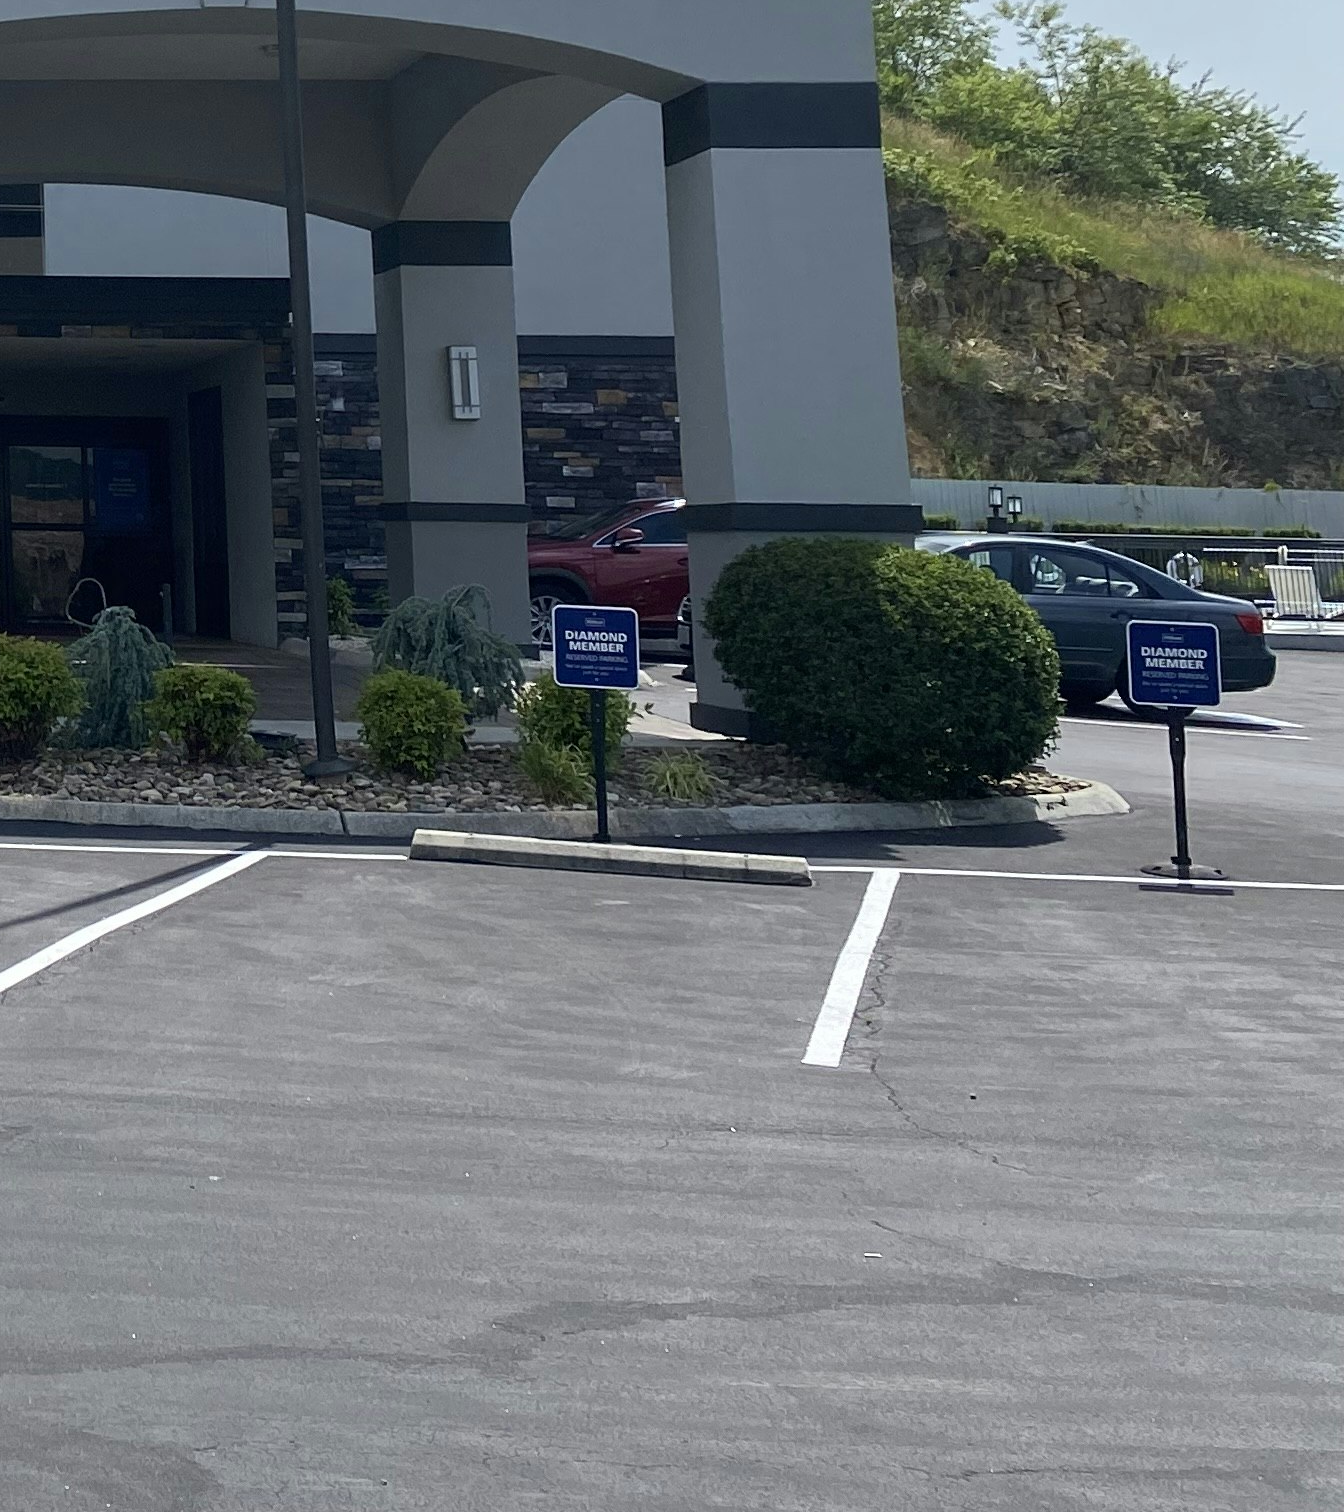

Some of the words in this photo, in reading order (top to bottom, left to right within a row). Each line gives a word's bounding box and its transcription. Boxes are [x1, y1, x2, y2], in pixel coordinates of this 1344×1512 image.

[564, 630, 628, 643] DIAMOND
[569, 641, 625, 653] MEMBER
[1140, 646, 1208, 659] DIAMOND
[565, 653, 598, 662] RESERVED
[1145, 657, 1205, 670] MEMBER
